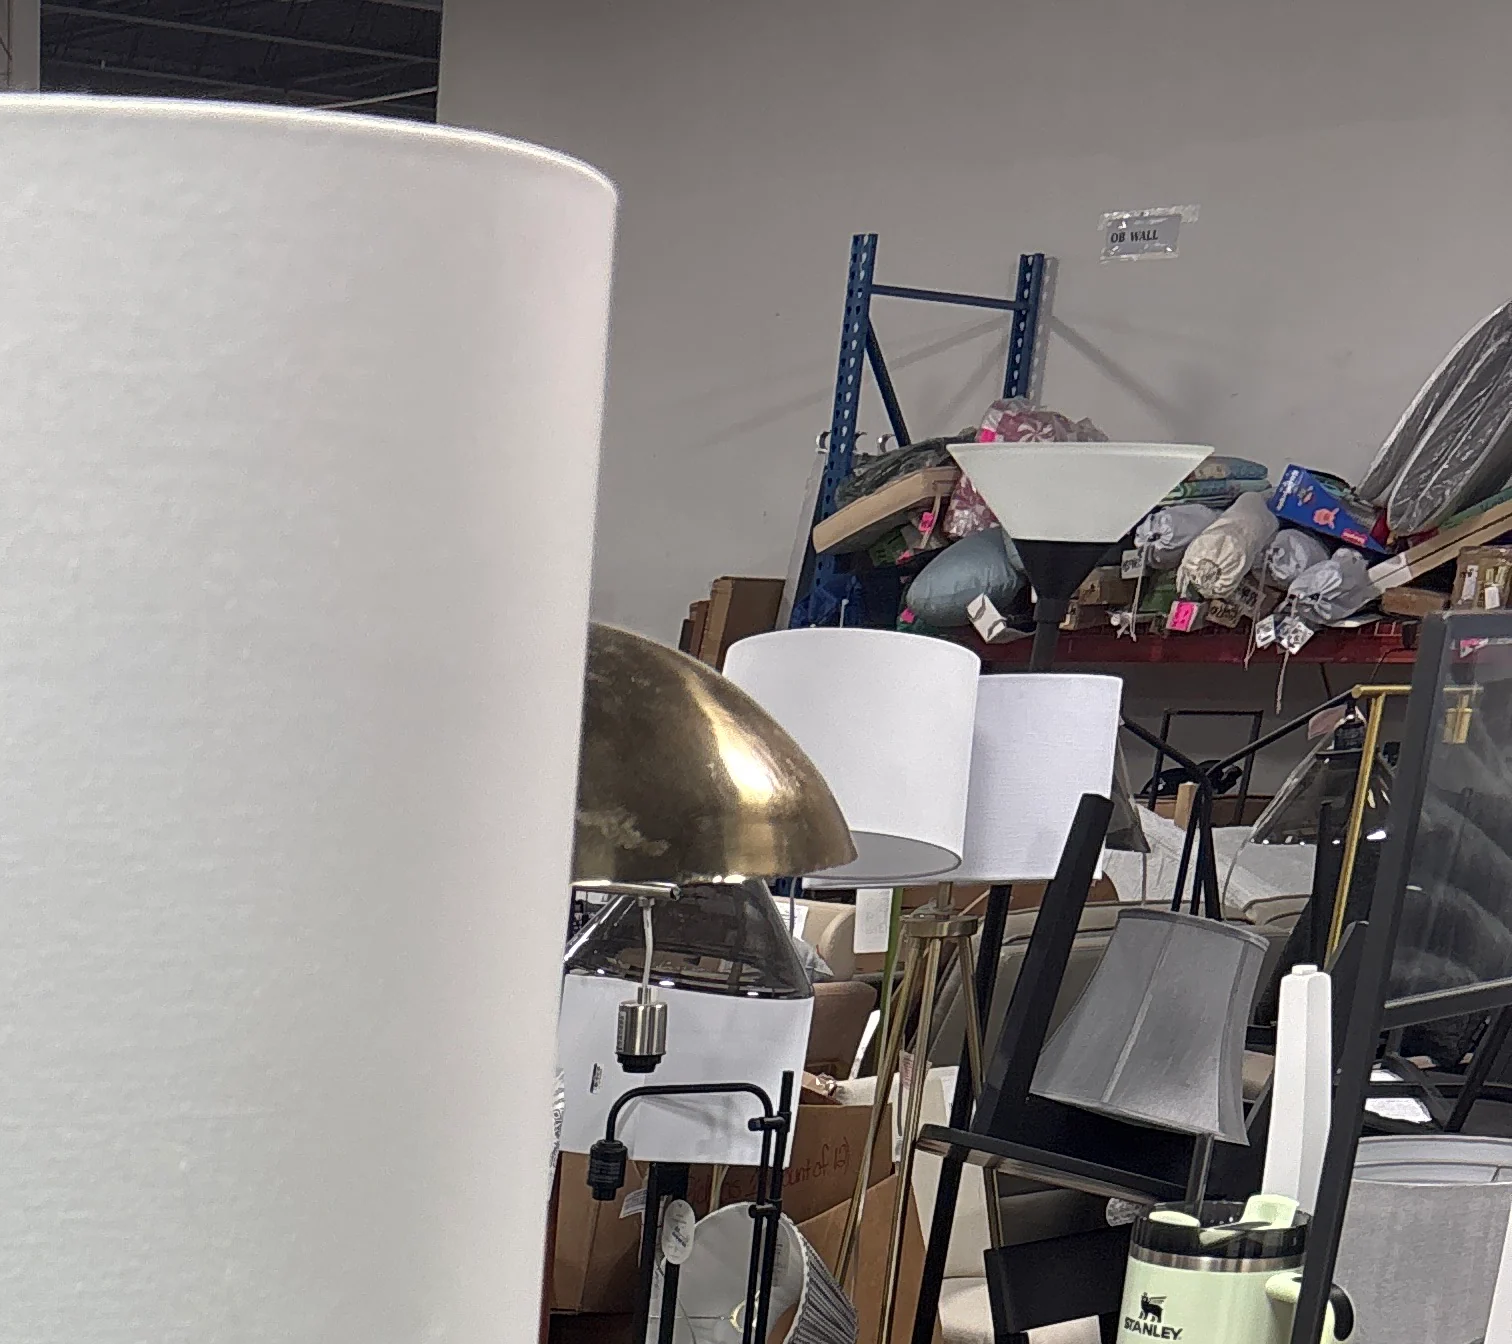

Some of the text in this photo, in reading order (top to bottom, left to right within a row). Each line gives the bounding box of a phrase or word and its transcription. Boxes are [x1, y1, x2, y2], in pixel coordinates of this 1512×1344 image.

[1110, 229, 1159, 243] OB WALL
[1124, 1316, 1184, 1341] STANLEY
